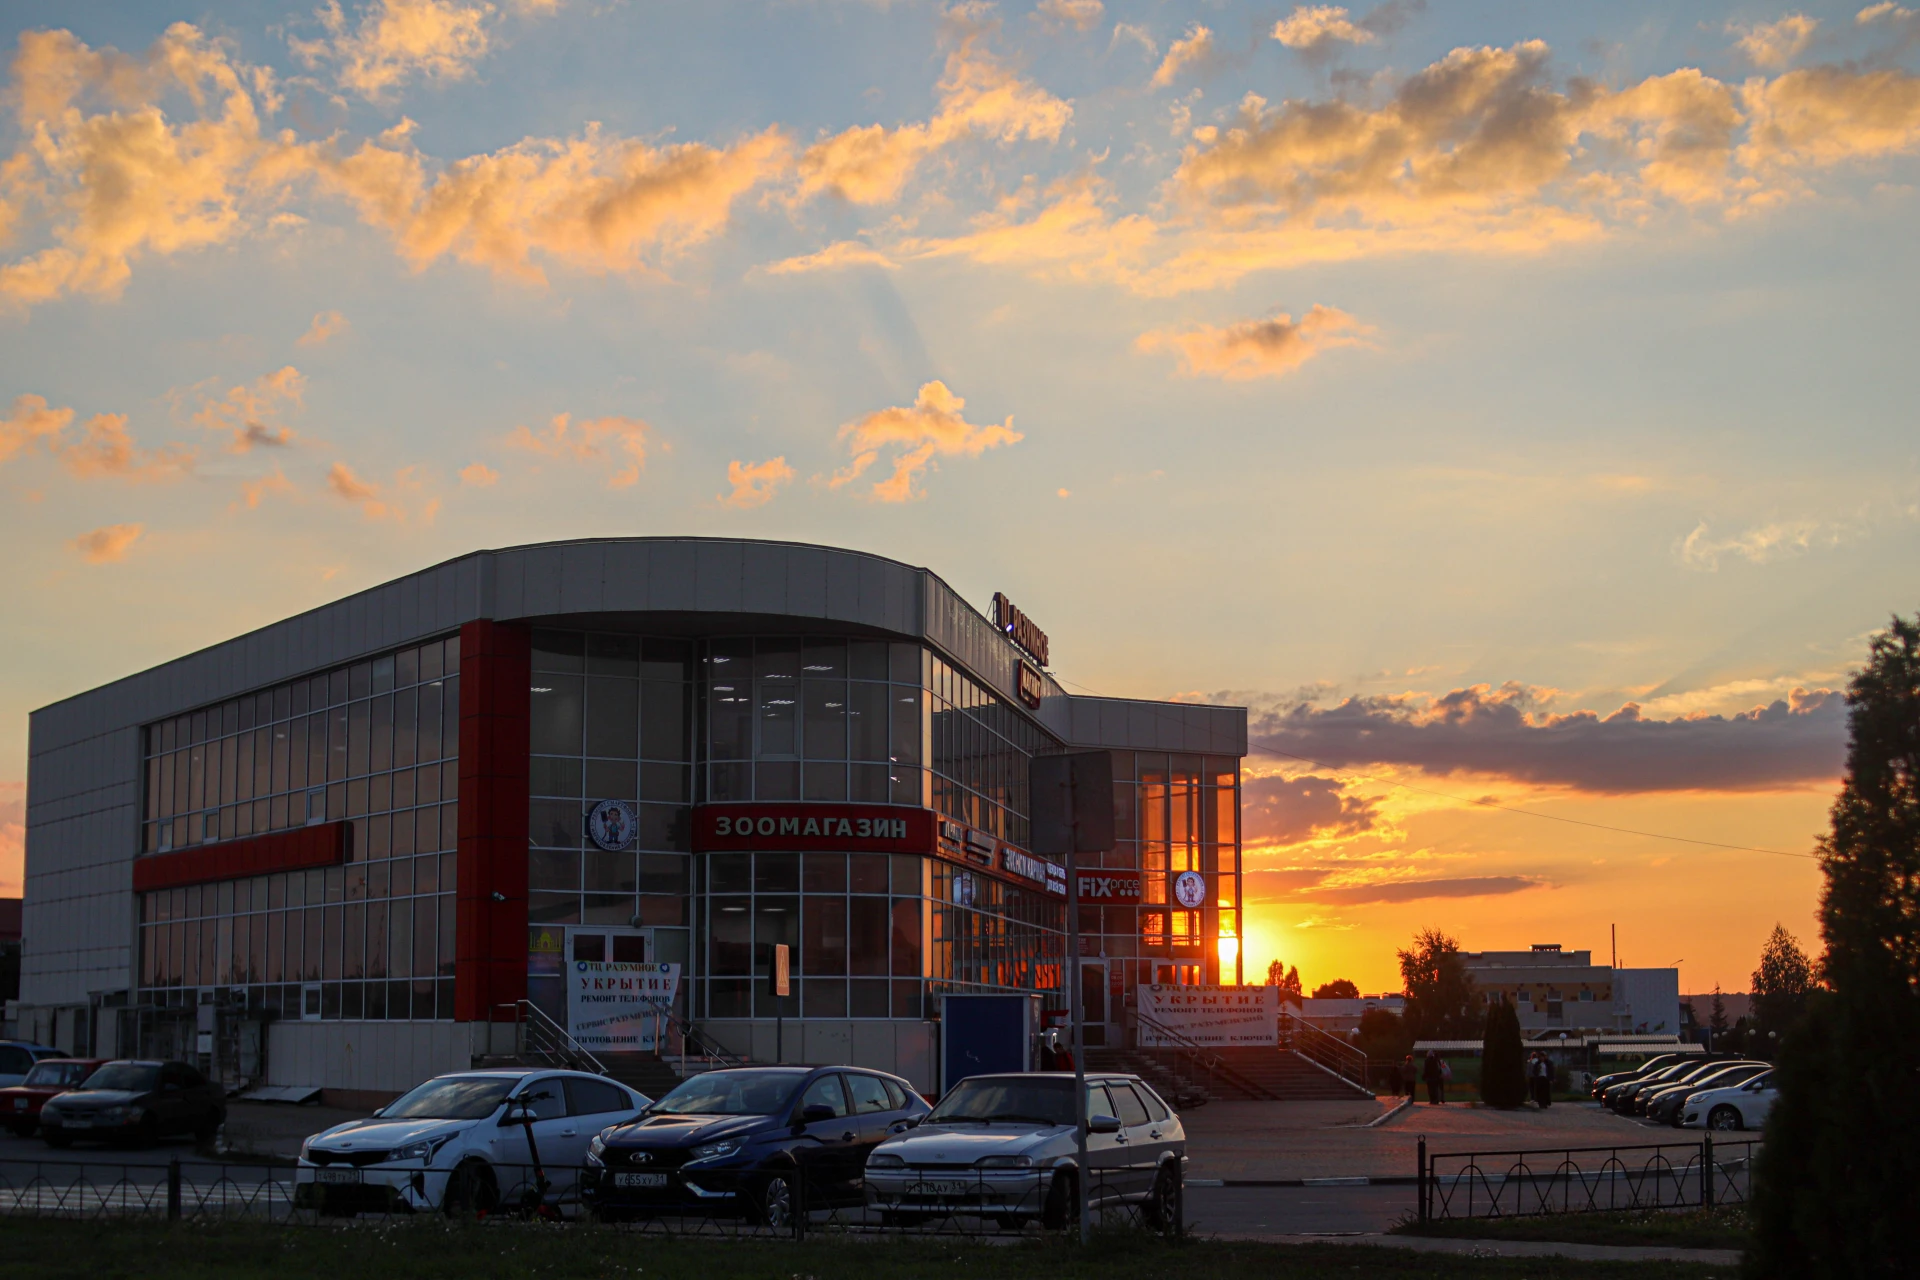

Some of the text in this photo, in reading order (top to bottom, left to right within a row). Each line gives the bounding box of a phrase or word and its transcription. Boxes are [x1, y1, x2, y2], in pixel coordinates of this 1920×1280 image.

[1010, 604, 1049, 667] РАЗУМНОЕ
[715, 816, 907, 839] ЗООМАГАЗИН
[589, 963, 658, 973] ТЦ РАЗУМНОЕ
[581, 978, 672, 990] УКРЫТИЕ
[581, 995, 670, 1003] РЕМОНТ ТЕЛЕФОНОВ
[1154, 995, 1265, 1005] УКРЫТИЕ
[576, 1019, 607, 1031] СЕРВИС
[1230, 1034, 1272, 1042] КЛЮЧЕЙ
[655, 1174, 664, 1183] 31
